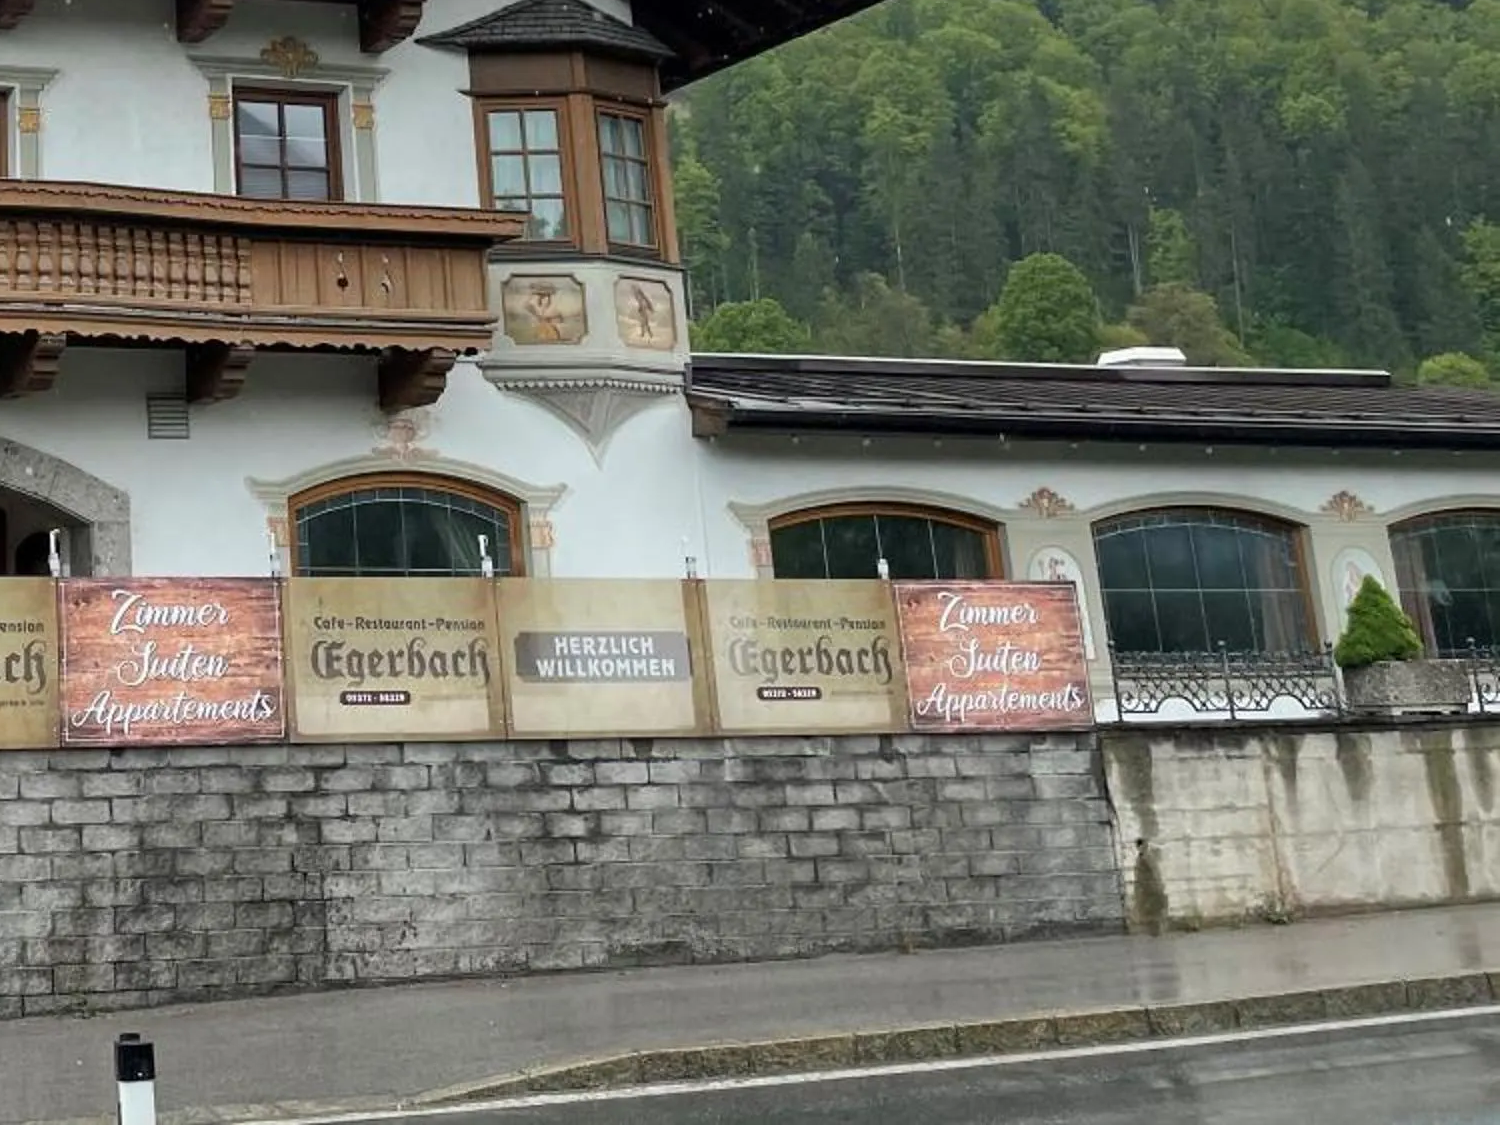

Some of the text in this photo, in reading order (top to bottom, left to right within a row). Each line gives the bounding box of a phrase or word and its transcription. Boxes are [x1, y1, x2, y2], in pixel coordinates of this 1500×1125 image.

[110, 589, 229, 635] Zimmer
[937, 592, 1039, 632] Zimmer
[115, 640, 228, 686] Suiten
[311, 636, 490, 687] Egerbach
[554, 636, 654, 656] HERZLICH
[729, 635, 893, 686] Egerbach
[949, 638, 1041, 678] Suiten
[536, 658, 675, 678] WILLKOMMEN
[71, 689, 277, 735] Appartements
[917, 683, 1085, 723] Appartements
